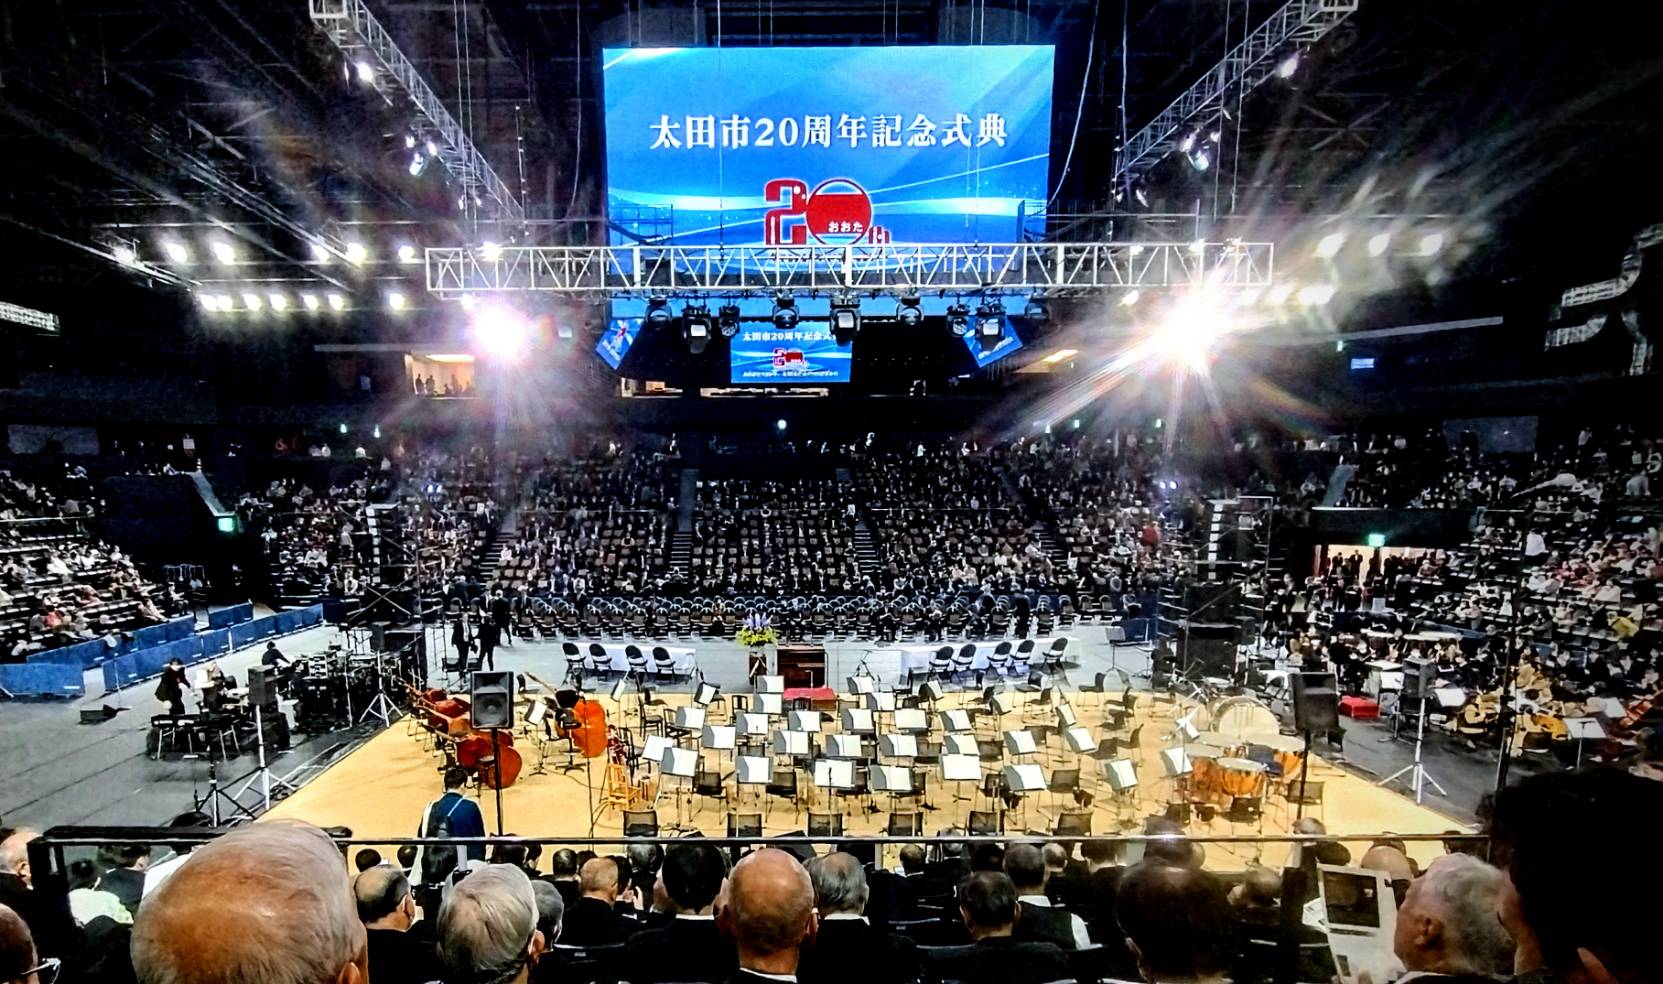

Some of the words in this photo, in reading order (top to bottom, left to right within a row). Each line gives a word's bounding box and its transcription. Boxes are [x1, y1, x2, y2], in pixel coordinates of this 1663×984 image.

[649, 113, 1008, 149] 太田市20周年記念式典
[828, 220, 863, 233] おおた
